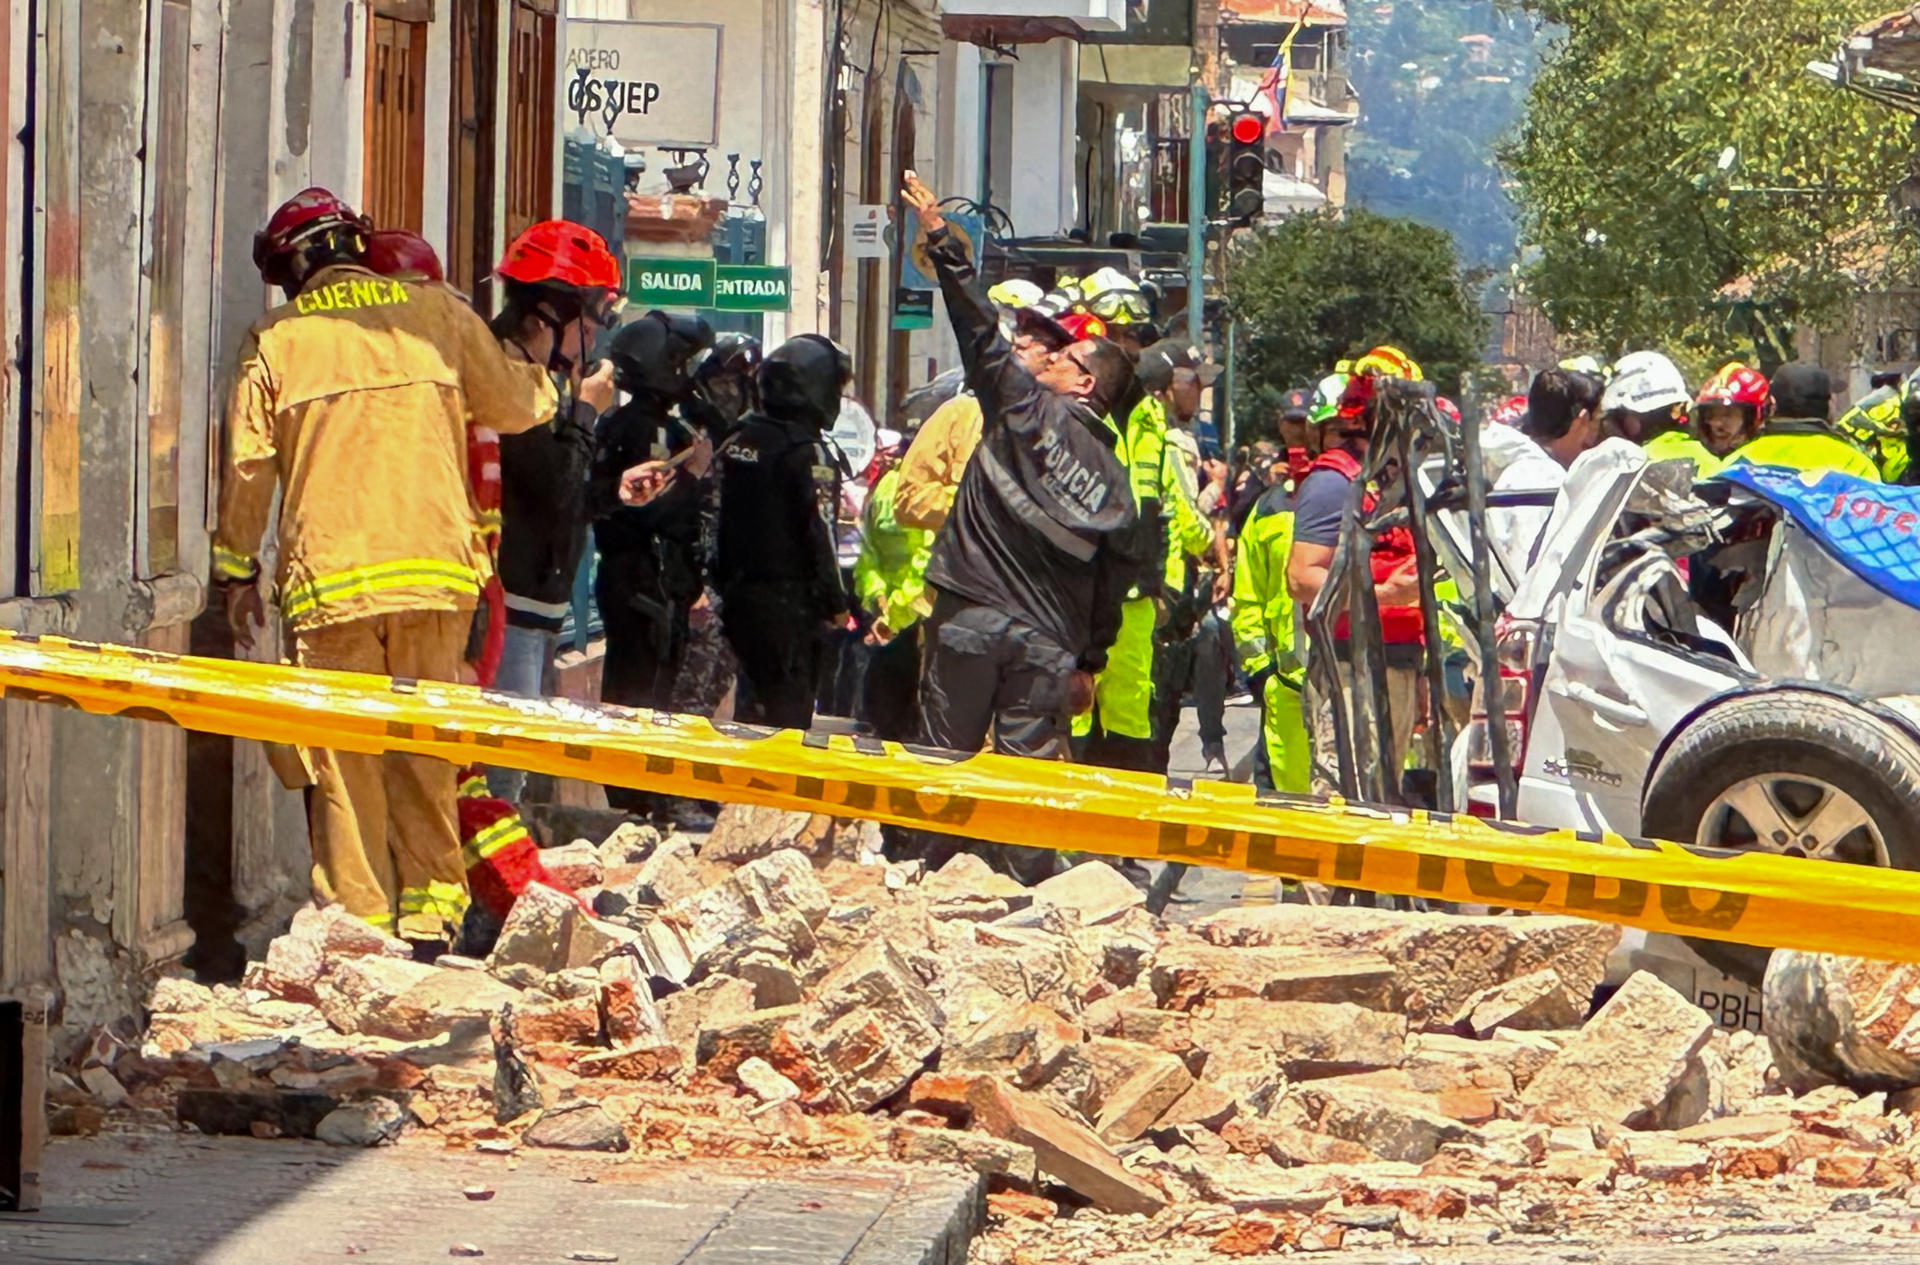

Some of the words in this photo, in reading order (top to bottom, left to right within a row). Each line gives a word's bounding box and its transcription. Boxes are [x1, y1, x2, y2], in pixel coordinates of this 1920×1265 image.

[640, 272, 702, 291] SALIDA
[716, 279, 786, 296] ENTRADA
[295, 280, 409, 315] CUENCA
